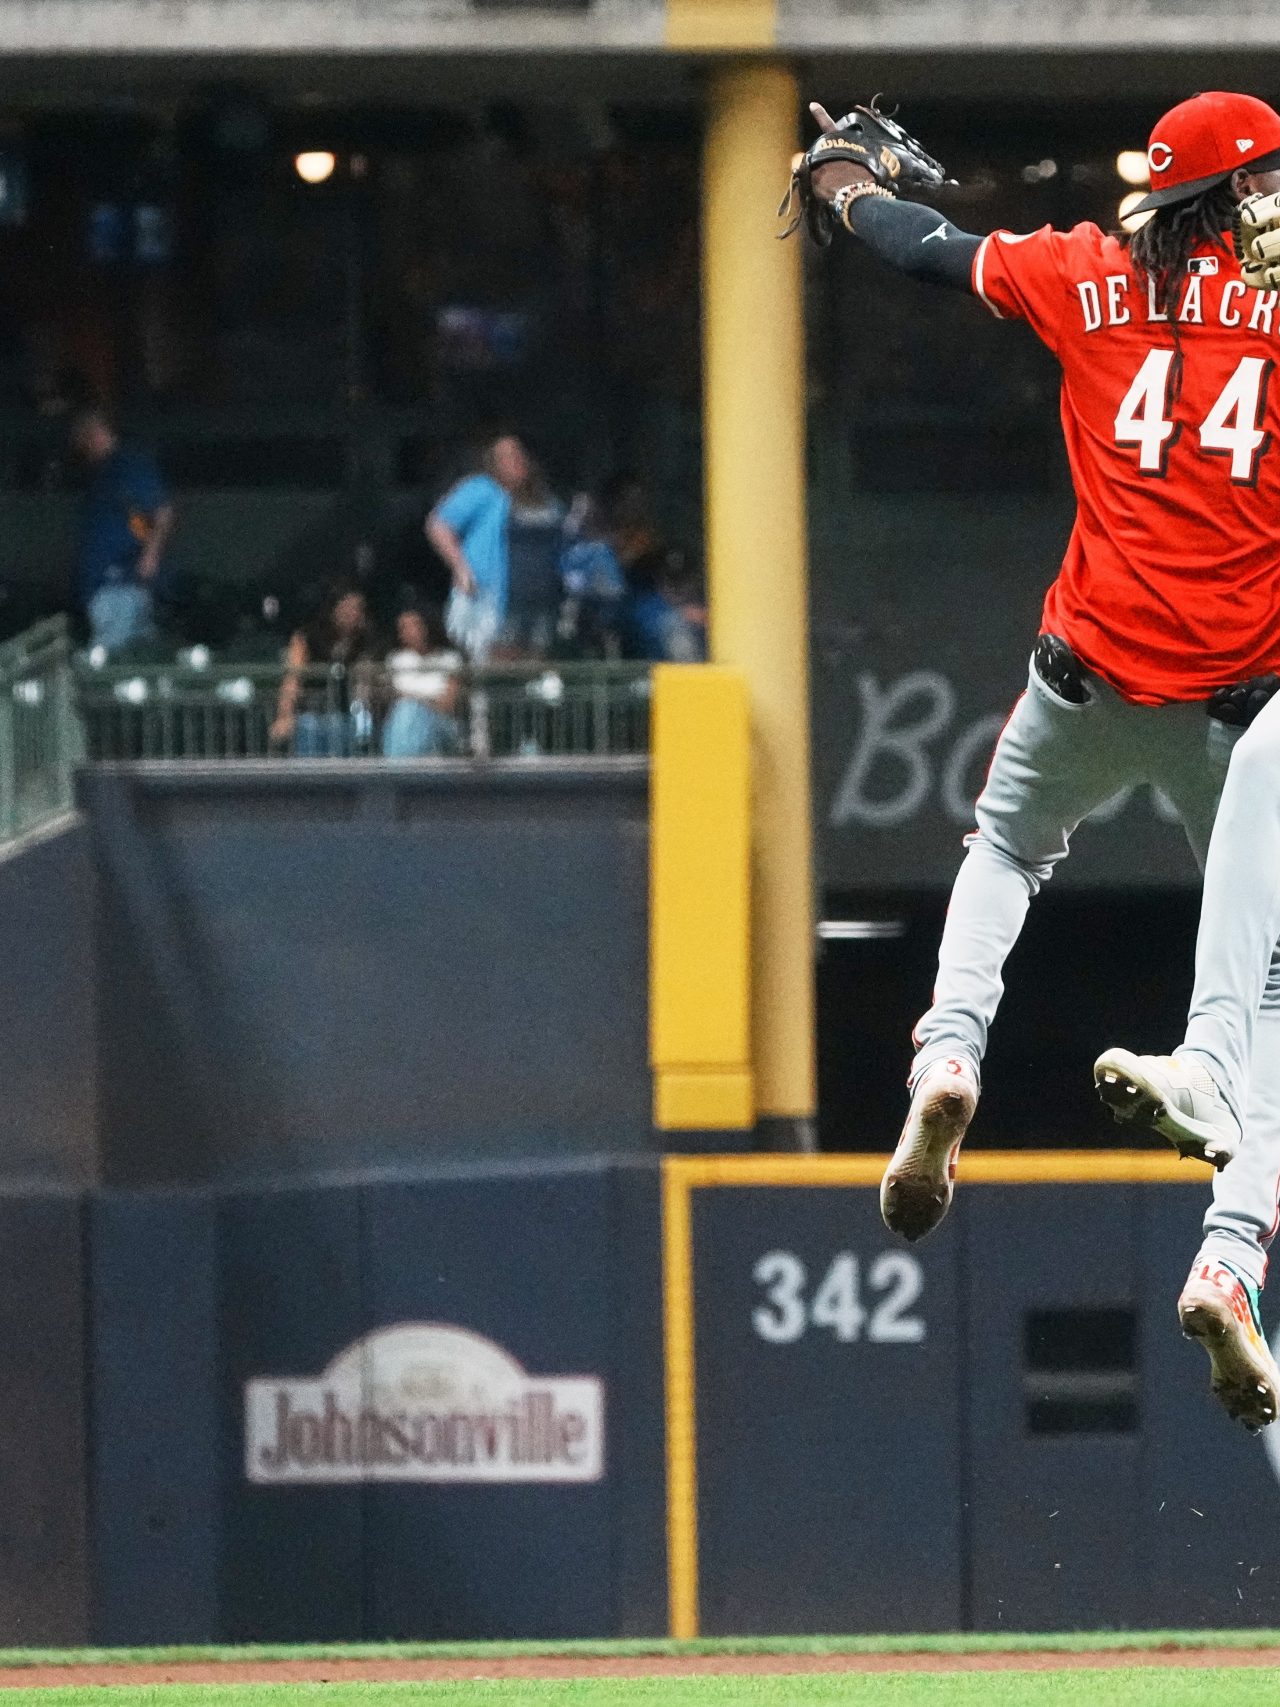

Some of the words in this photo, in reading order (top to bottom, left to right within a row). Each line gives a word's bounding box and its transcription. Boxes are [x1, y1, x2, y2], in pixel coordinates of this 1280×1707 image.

[1077, 274, 1131, 332] DE
[1147, 273, 1203, 323] LA
[1114, 347, 1275, 488] 44
[753, 1251, 925, 1344] 342
